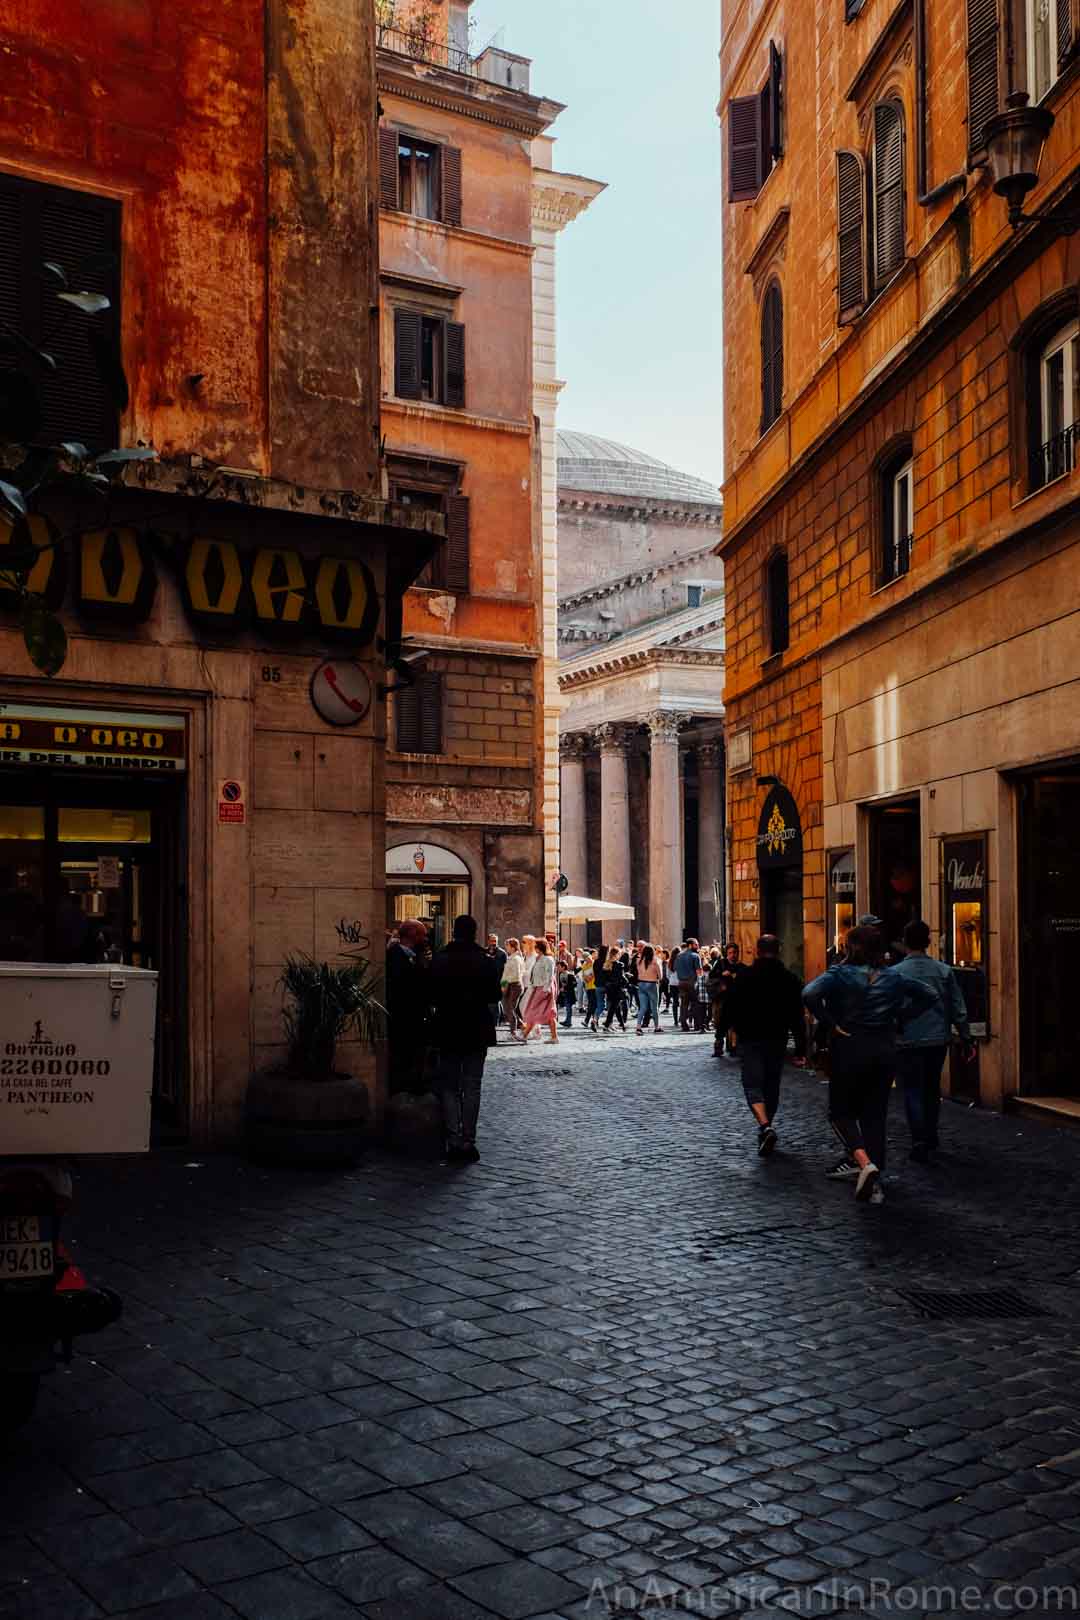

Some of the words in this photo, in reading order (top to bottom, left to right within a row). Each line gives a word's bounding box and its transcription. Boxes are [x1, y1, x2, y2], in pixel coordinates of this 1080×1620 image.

[262, 666, 280, 683] 85
[947, 857, 985, 891] Venchi
[8, 1091, 94, 1104] PANTHEON
